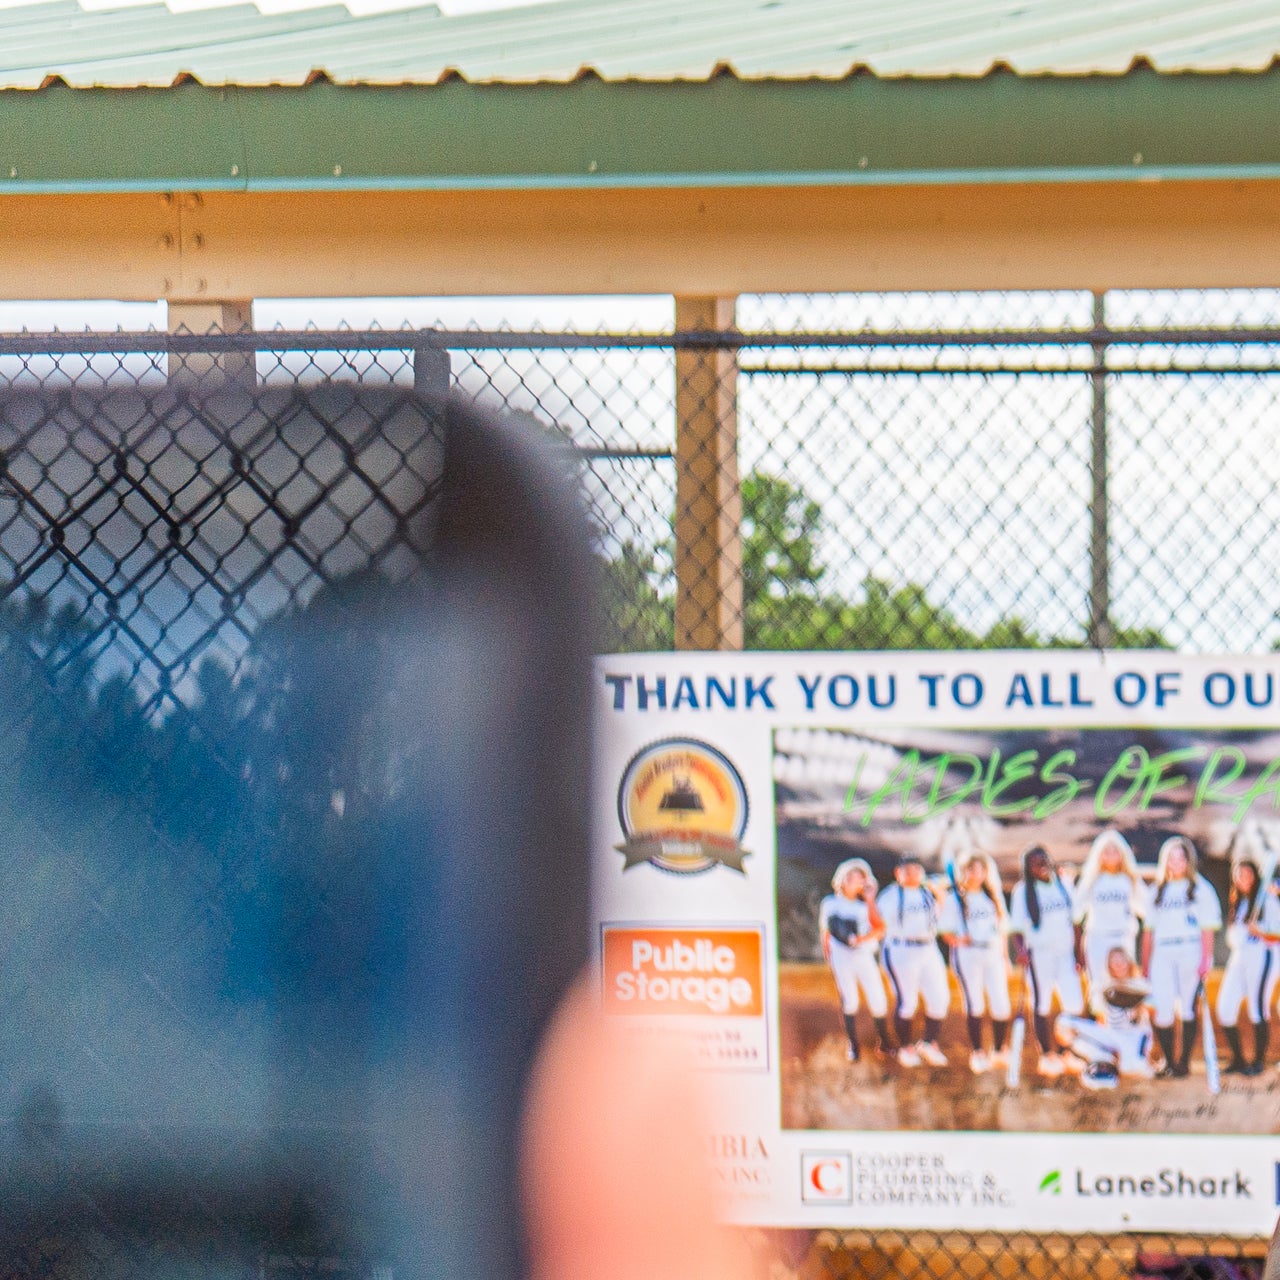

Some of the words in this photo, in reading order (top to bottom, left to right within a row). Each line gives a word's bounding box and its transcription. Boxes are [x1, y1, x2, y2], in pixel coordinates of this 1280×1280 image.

[603, 673, 776, 711] THANK
[799, 673, 897, 710] YOU
[919, 672, 985, 709] TO
[1005, 672, 1093, 708] ALL
[1113, 671, 1181, 708] OF
[843, 746, 1094, 827] LADIES
[1093, 745, 1206, 819] OF
[632, 938, 736, 974] Public
[615, 970, 753, 1011] Storage
[810, 1159, 843, 1197] C
[857, 1152, 946, 1169] COOPER
[857, 1171, 975, 1187] PLUMBING
[857, 1189, 967, 1205] COMPANY
[1075, 1167, 1254, 1199] LaneShark
